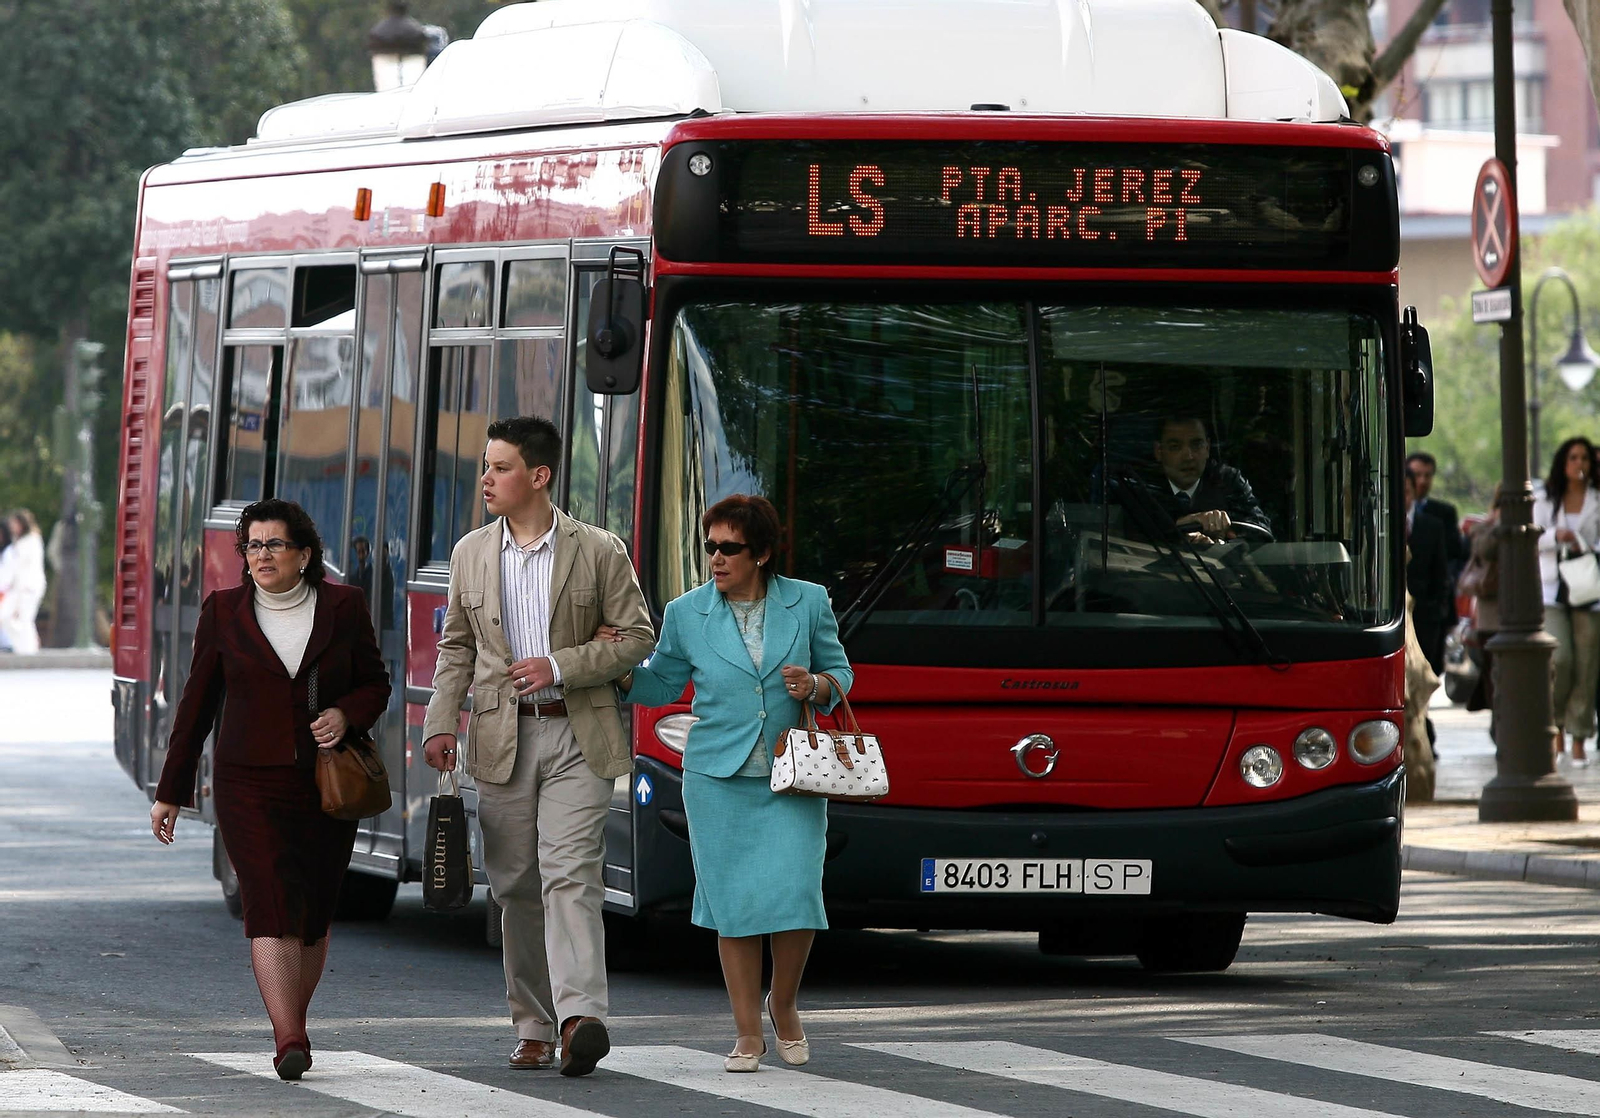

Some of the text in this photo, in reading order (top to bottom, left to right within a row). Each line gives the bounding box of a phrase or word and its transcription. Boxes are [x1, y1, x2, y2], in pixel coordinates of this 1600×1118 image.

[808, 163, 886, 237] LS
[941, 165, 1202, 204] PTA. JEREZ
[957, 203, 1188, 241] APARC. PI
[1000, 678, 1081, 690] Castrosua
[433, 815, 452, 890] Lumen
[925, 878, 932, 886] E
[943, 862, 1010, 889] 8403
[1022, 863, 1072, 889] FLH
